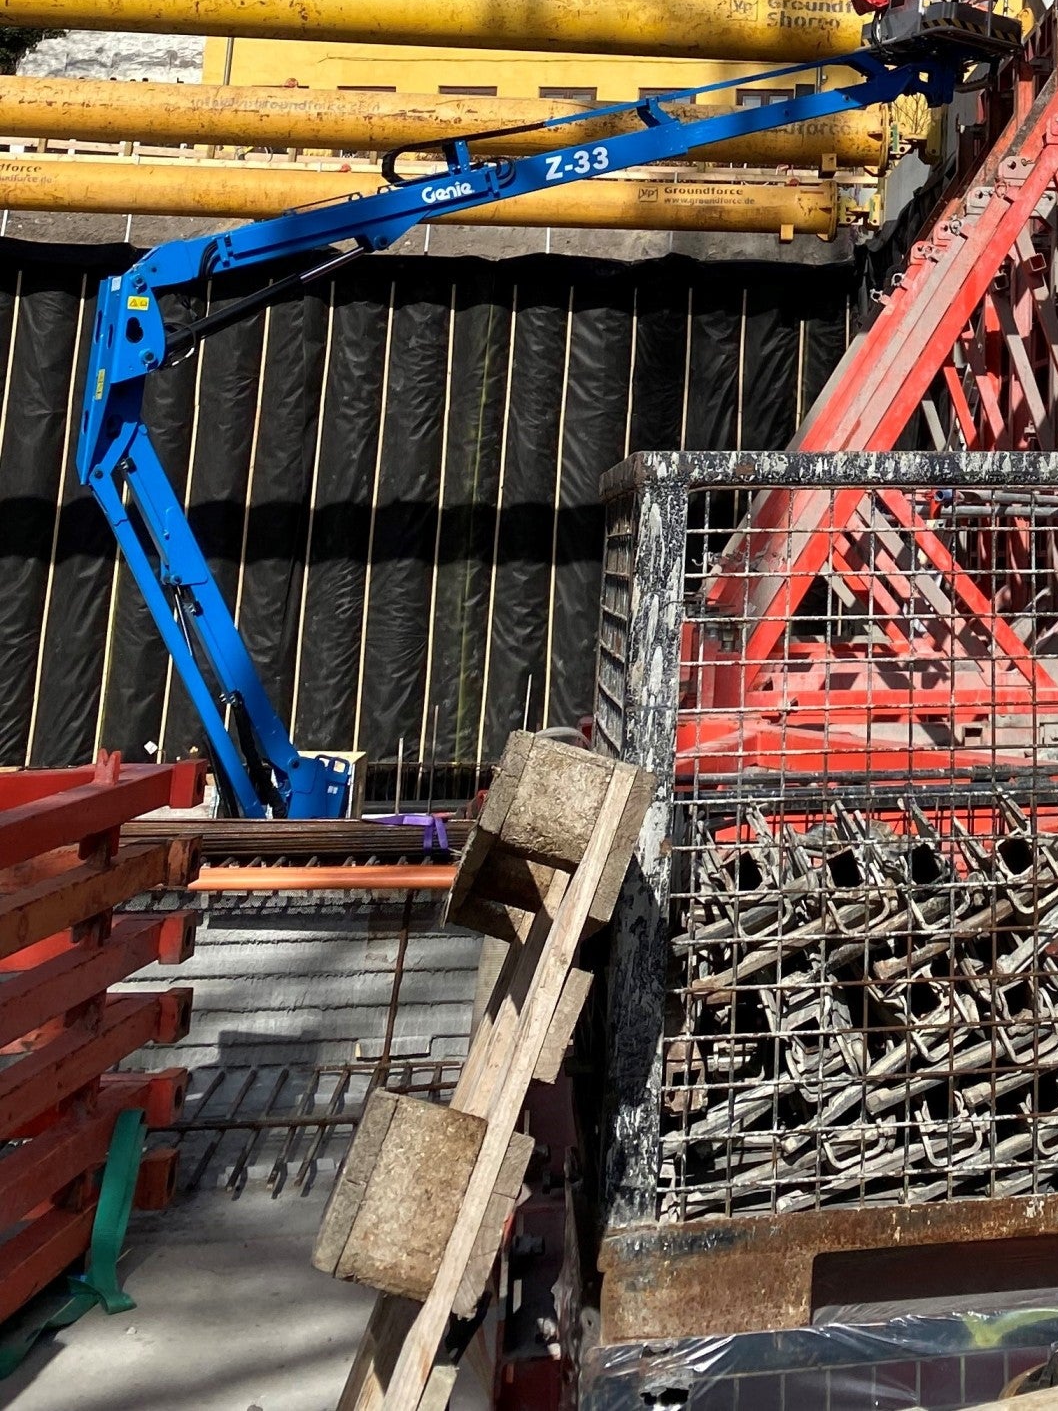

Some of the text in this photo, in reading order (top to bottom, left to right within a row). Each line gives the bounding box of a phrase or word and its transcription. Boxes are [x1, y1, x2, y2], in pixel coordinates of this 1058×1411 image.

[545, 147, 609, 181] Z-33
[421, 180, 475, 204] Genie
[664, 186, 744, 195] Groundforce
